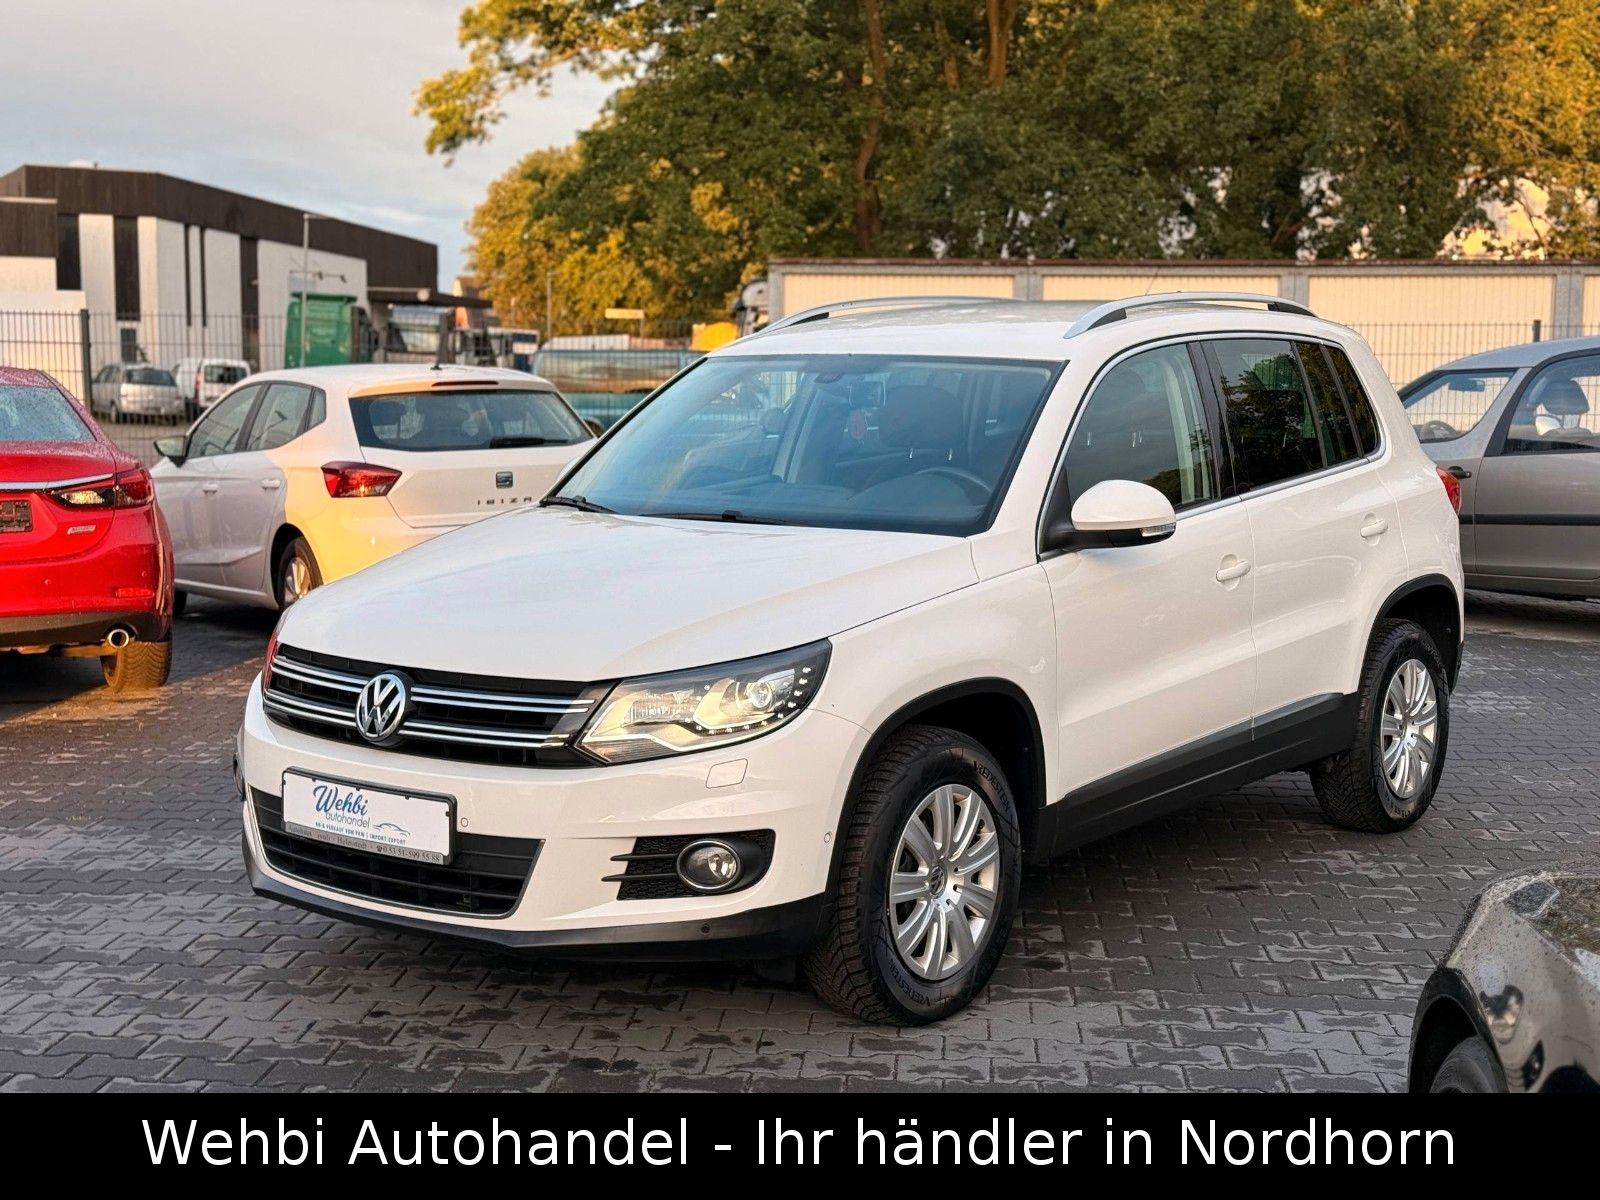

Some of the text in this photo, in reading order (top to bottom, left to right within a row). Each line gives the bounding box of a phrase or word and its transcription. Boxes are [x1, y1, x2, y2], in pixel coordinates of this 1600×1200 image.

[477, 497, 532, 505] IBIZA
[313, 785, 368, 815] Wehbi
[325, 811, 370, 828] autohandel
[369, 834, 386, 842] IMPORT
[388, 837, 406, 846] EXPORT
